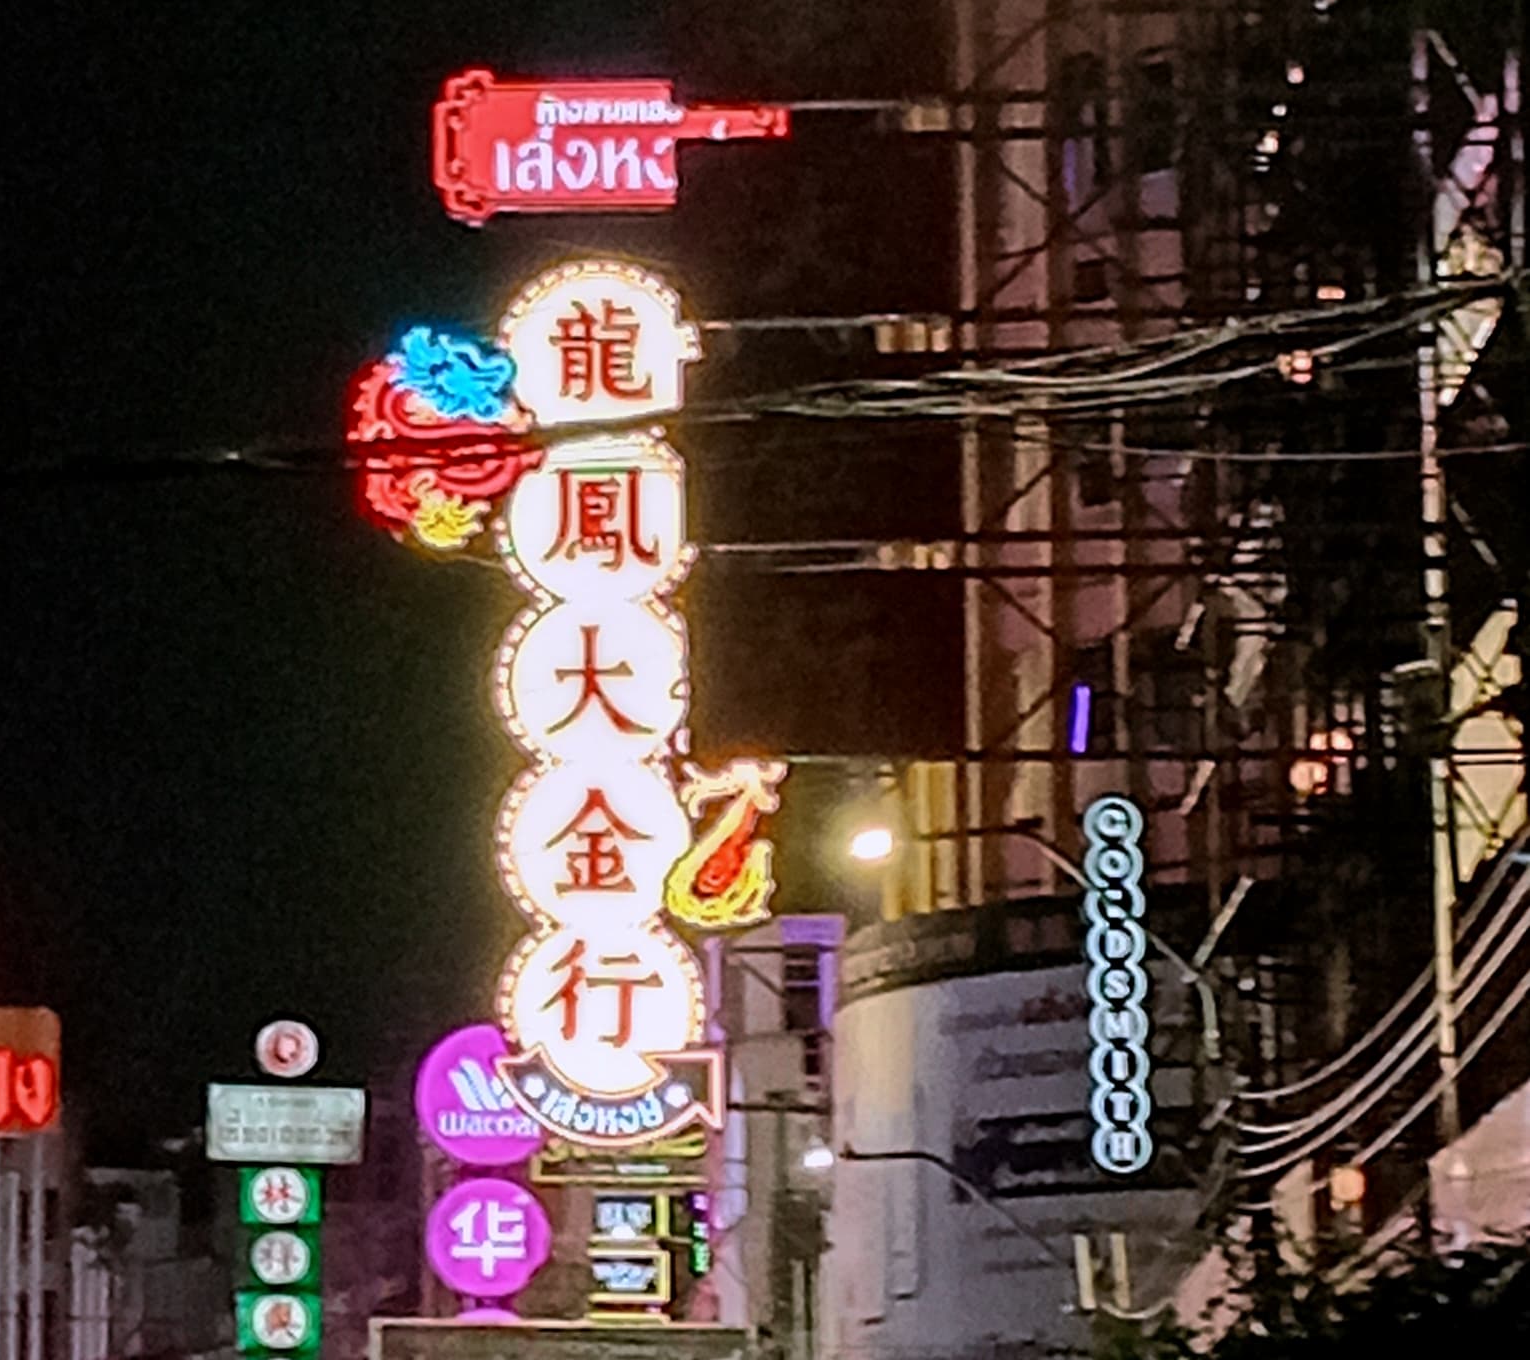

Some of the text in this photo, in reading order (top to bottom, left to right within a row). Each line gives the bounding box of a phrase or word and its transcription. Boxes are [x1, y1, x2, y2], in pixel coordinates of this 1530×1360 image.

[543, 299, 663, 1048] 龍鳳大金行
[451, 1200, 526, 1277] 华
